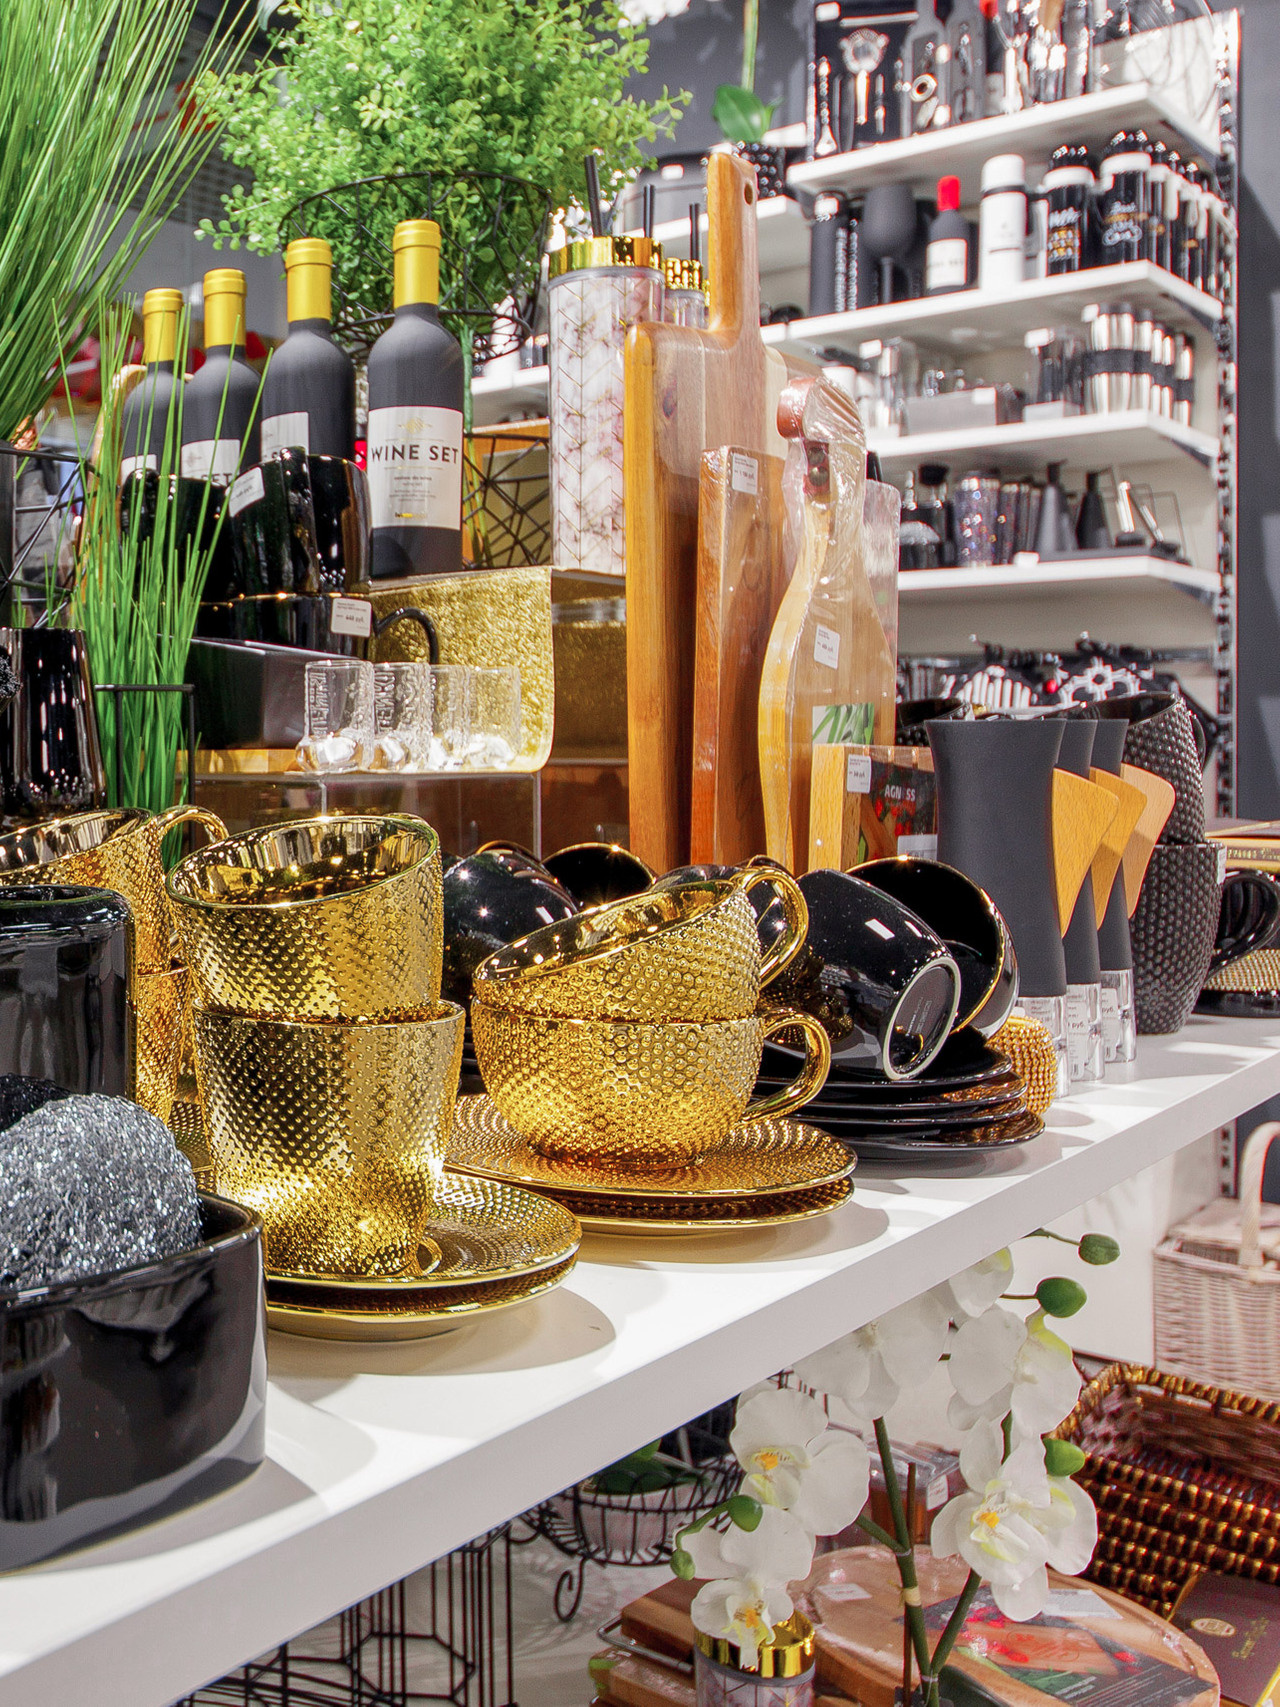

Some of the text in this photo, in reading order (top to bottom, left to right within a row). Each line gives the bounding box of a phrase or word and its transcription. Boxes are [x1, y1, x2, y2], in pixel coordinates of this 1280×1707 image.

[371, 444, 459, 464] WINE SET
[201, 472, 232, 486] ET
[884, 784, 916, 802] AGNSS
